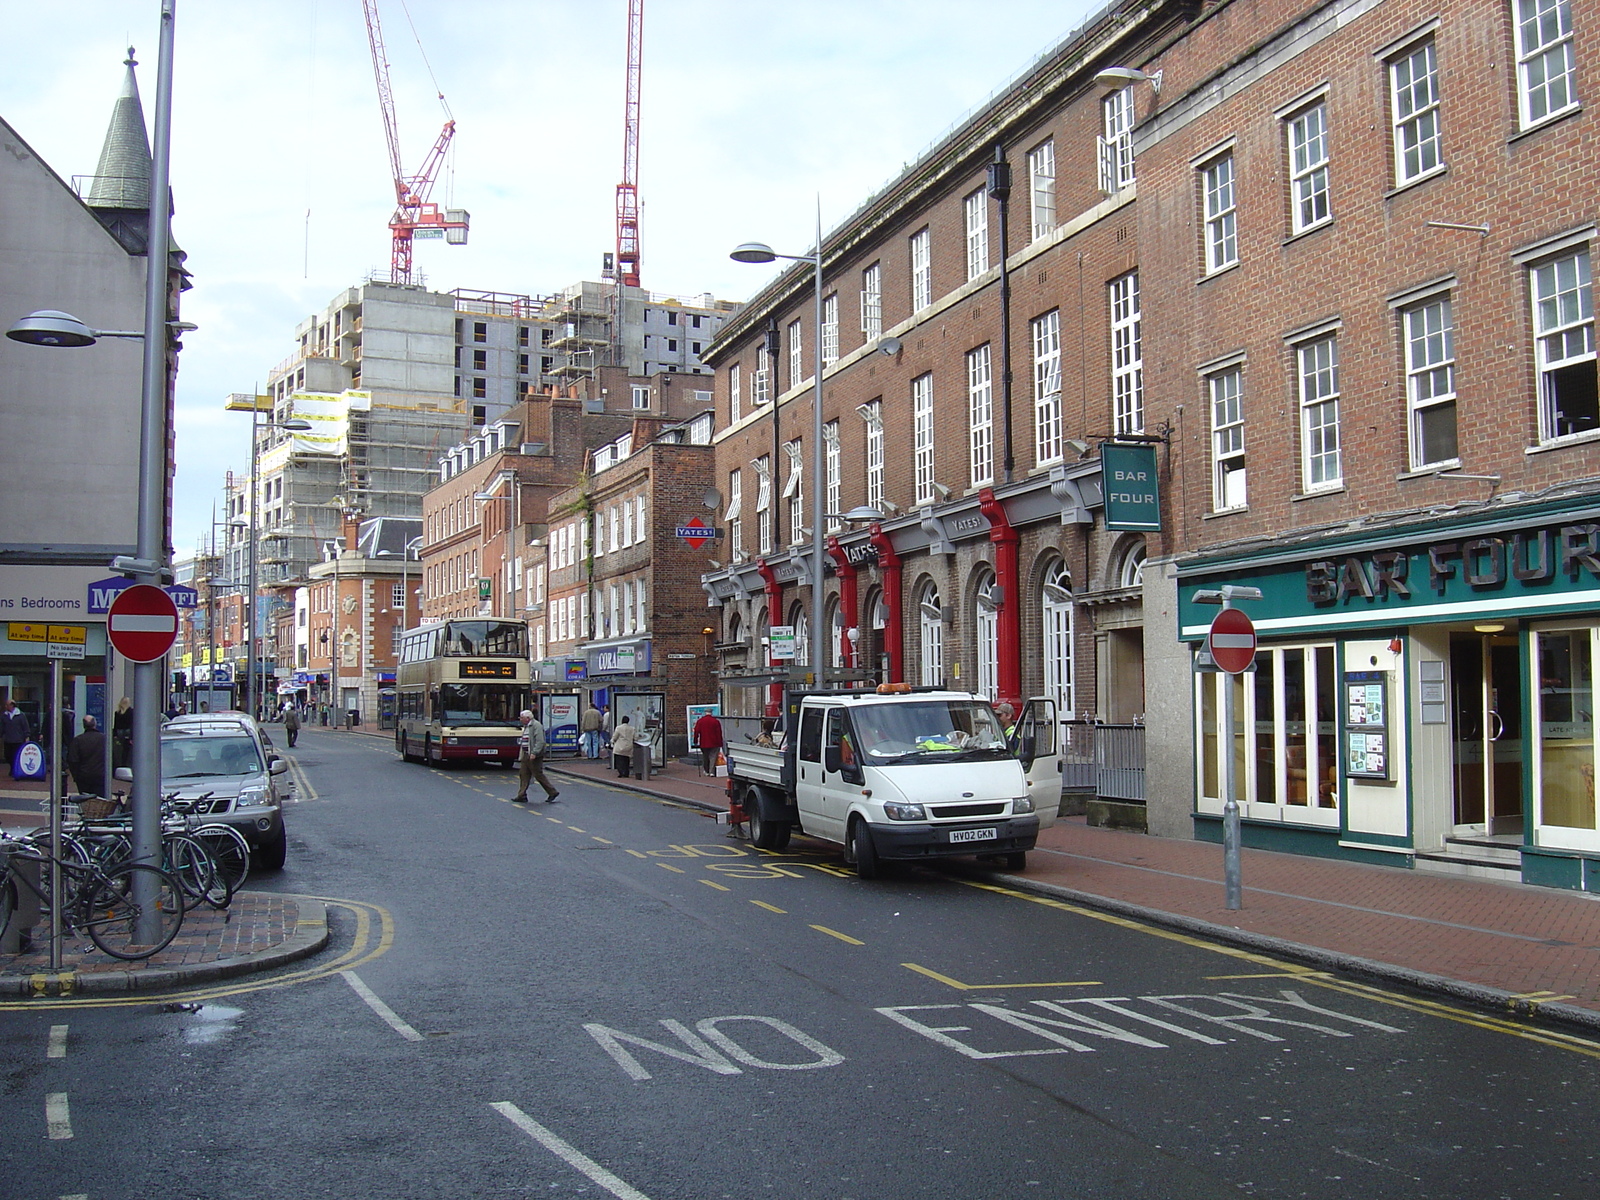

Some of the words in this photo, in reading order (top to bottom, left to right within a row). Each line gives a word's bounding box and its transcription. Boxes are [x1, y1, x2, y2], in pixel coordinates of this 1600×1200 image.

[1114, 470, 1147, 482] BAR
[1110, 492, 1155, 504] FOUR
[1305, 550, 1411, 603] BAR
[1428, 524, 1600, 590] FOUR
[21, 597, 81, 609] Bedrooms
[598, 651, 618, 670] CORA
[953, 831, 976, 842] HV02
[977, 829, 994, 839] GKN
[581, 1014, 846, 1081] NO
[873, 990, 1407, 1060] ENTRY
